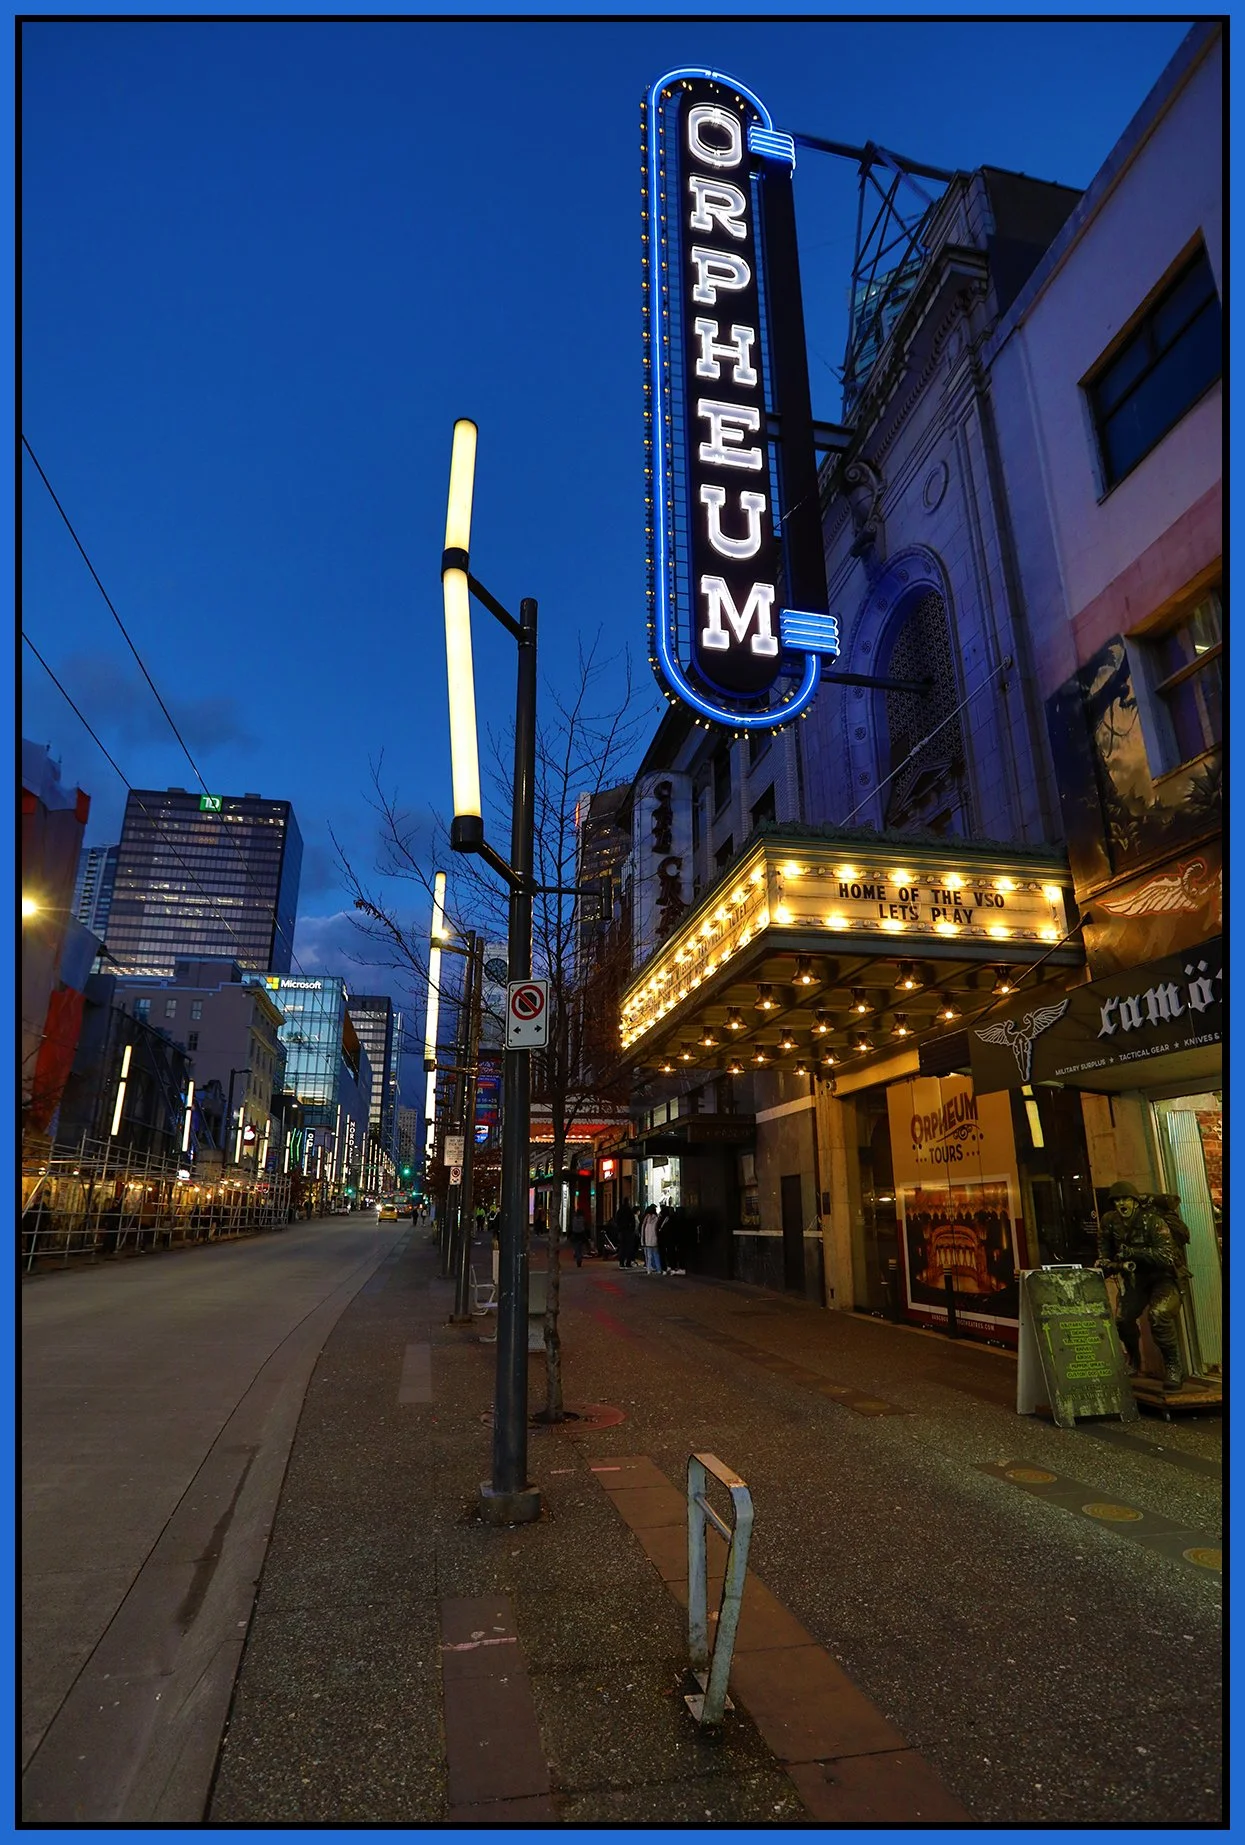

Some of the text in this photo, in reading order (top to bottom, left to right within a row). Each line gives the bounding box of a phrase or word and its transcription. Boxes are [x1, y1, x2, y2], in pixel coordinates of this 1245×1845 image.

[686, 102, 780, 657] ORPHEUM
[202, 796, 220, 809] TD
[838, 883, 1005, 908] HOME OF THE VSO
[878, 903, 974, 924] LETS PLAY
[280, 979, 322, 990] Microsoft
[1055, 1065, 1080, 1076] MILITARY
[1081, 1058, 1107, 1071] SURPLUS
[1119, 1049, 1150, 1061] TACTICAL
[1150, 1043, 1170, 1054] GEAR
[1184, 1034, 1213, 1047] KNIVES
[911, 1091, 979, 1144] ORPHEUM
[929, 1143, 963, 1164] TOURS
